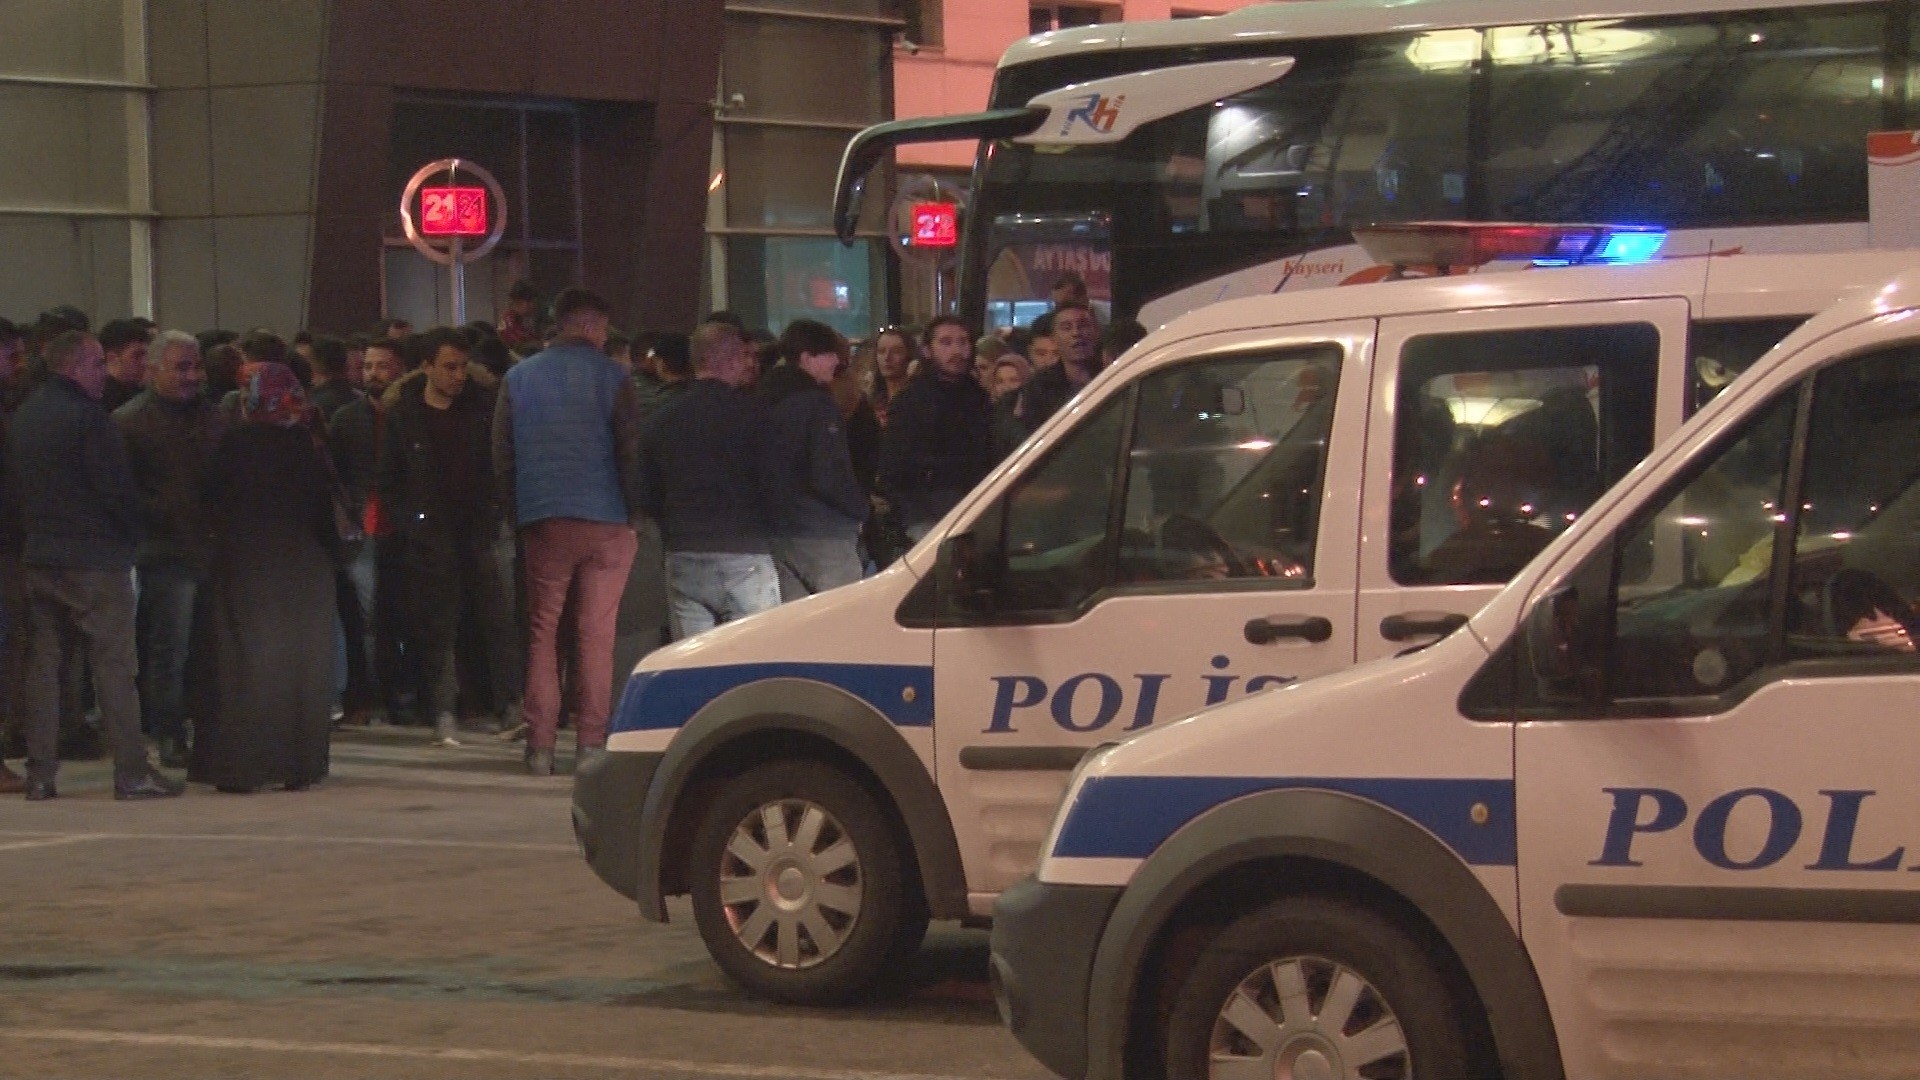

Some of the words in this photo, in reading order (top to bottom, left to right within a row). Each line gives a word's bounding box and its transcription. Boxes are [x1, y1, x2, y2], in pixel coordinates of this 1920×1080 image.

[425, 193, 455, 221] 21
[1282, 260, 1344, 279] Kayseri
[1587, 787, 1920, 872] POL
